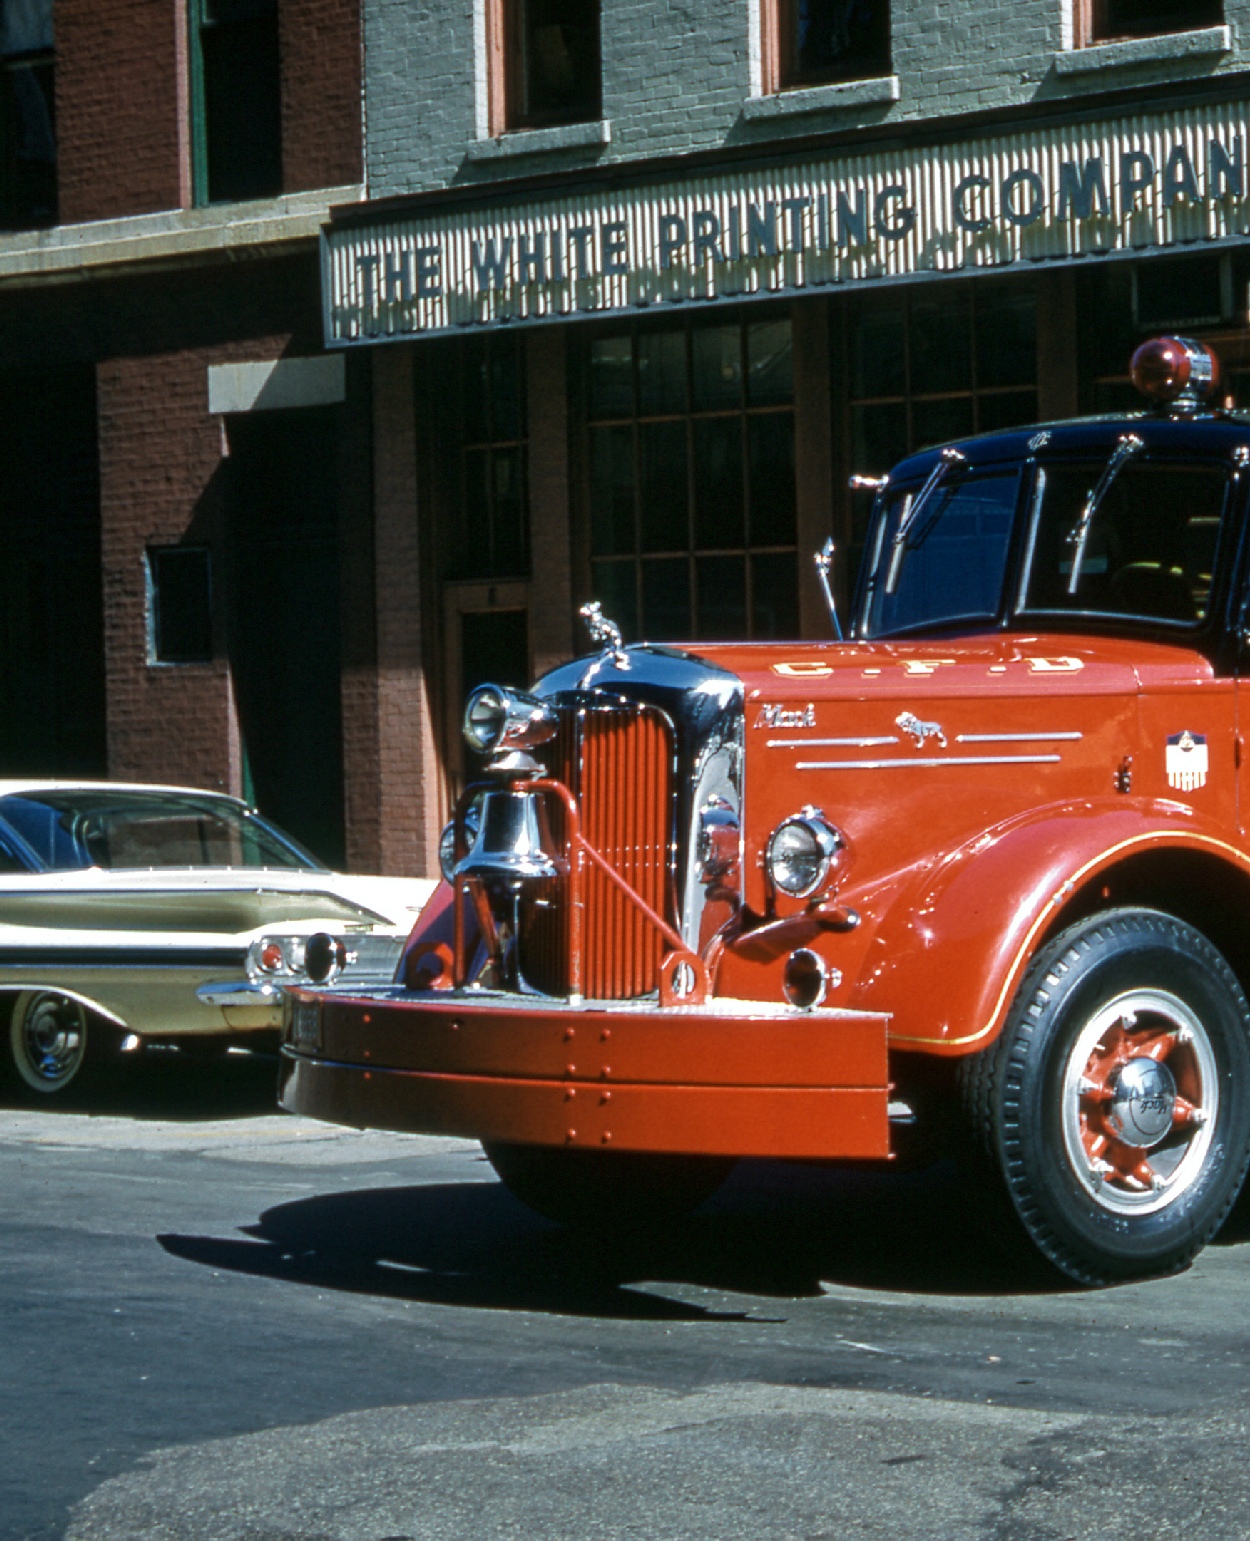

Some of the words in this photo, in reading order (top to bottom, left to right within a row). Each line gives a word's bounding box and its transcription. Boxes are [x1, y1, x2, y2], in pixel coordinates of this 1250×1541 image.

[355, 246, 442, 303] THE
[472, 221, 629, 291] WHITE
[659, 185, 916, 270] PRINTING
[753, 703, 817, 729] Mack
